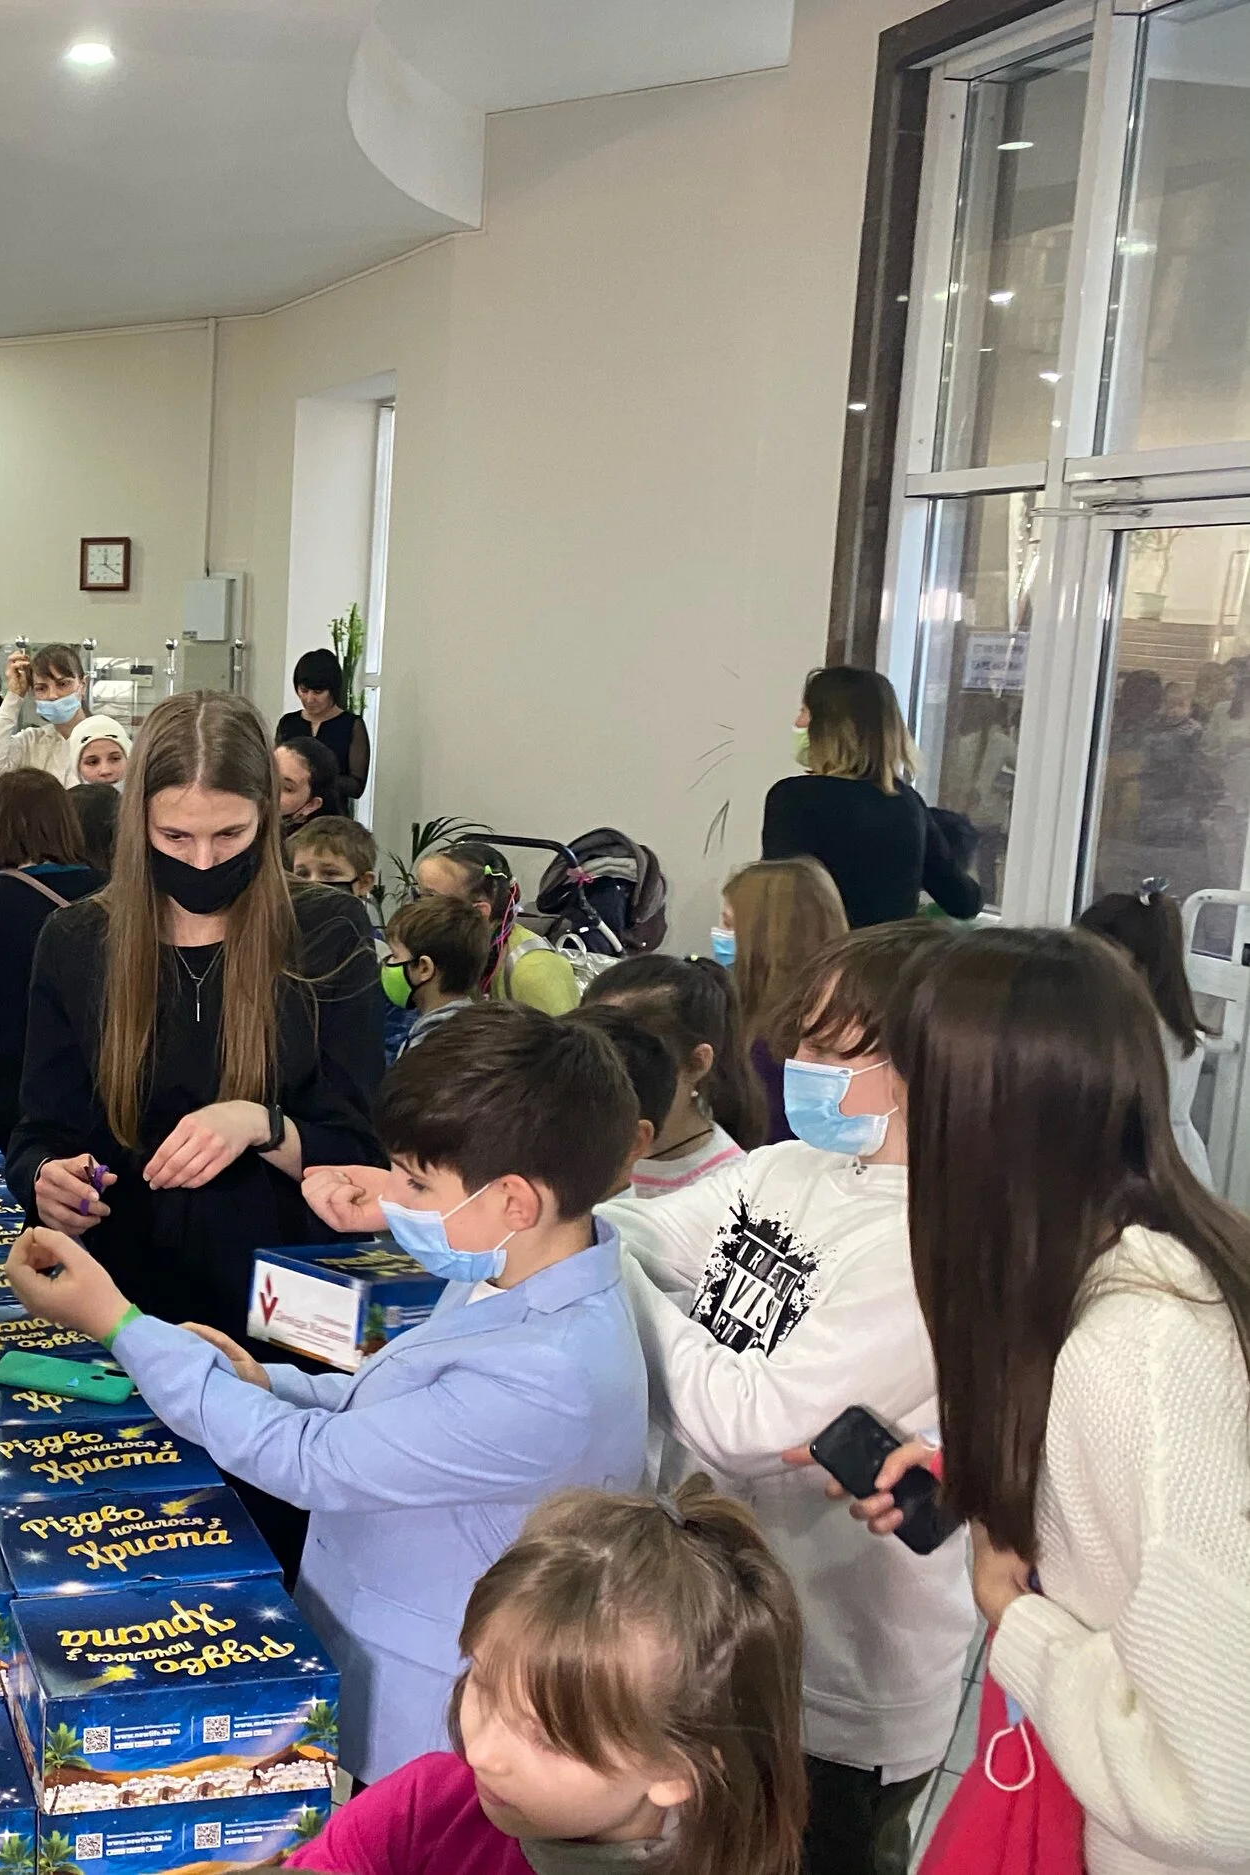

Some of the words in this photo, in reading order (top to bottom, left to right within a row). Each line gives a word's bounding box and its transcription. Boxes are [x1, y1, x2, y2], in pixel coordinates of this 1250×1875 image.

[69, 1439, 158, 1457] почалося
[160, 1440, 174, 1450] з
[30, 1449, 182, 1485] Христа
[20, 1505, 145, 1540] Різдво
[108, 1517, 205, 1537] почалося
[207, 1517, 222, 1530] з
[67, 1528, 233, 1572] Христа
[57, 1600, 236, 1647] Христа
[65, 1647, 83, 1661] з
[86, 1640, 195, 1663] почалося
[153, 1635, 296, 1676] Різдво
